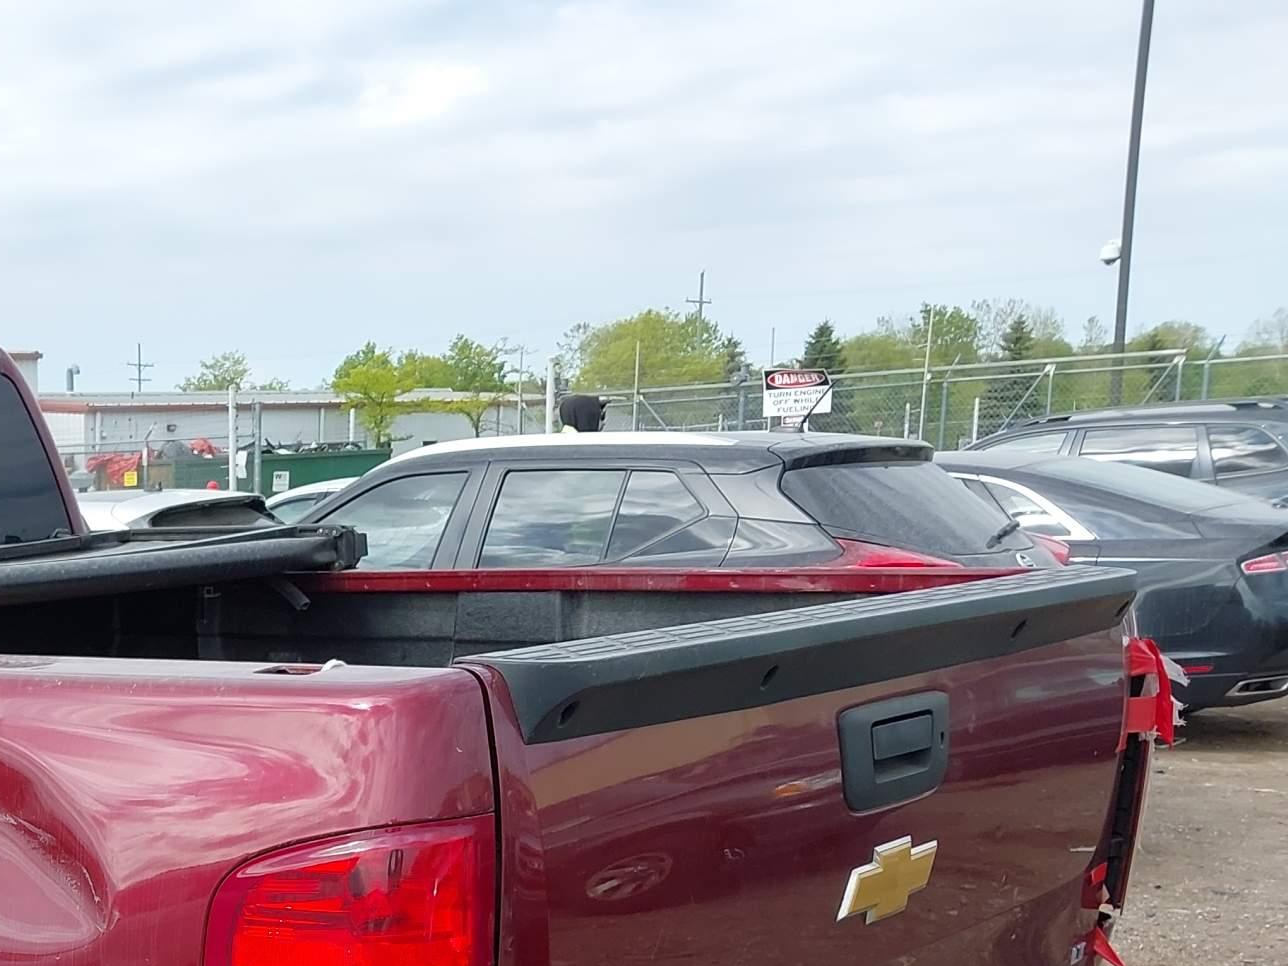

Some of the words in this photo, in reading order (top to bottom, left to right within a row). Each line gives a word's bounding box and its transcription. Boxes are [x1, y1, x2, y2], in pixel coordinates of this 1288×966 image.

[774, 372, 819, 385] DANGER
[768, 391, 792, 399] TURN
[772, 398, 791, 407] OFF
